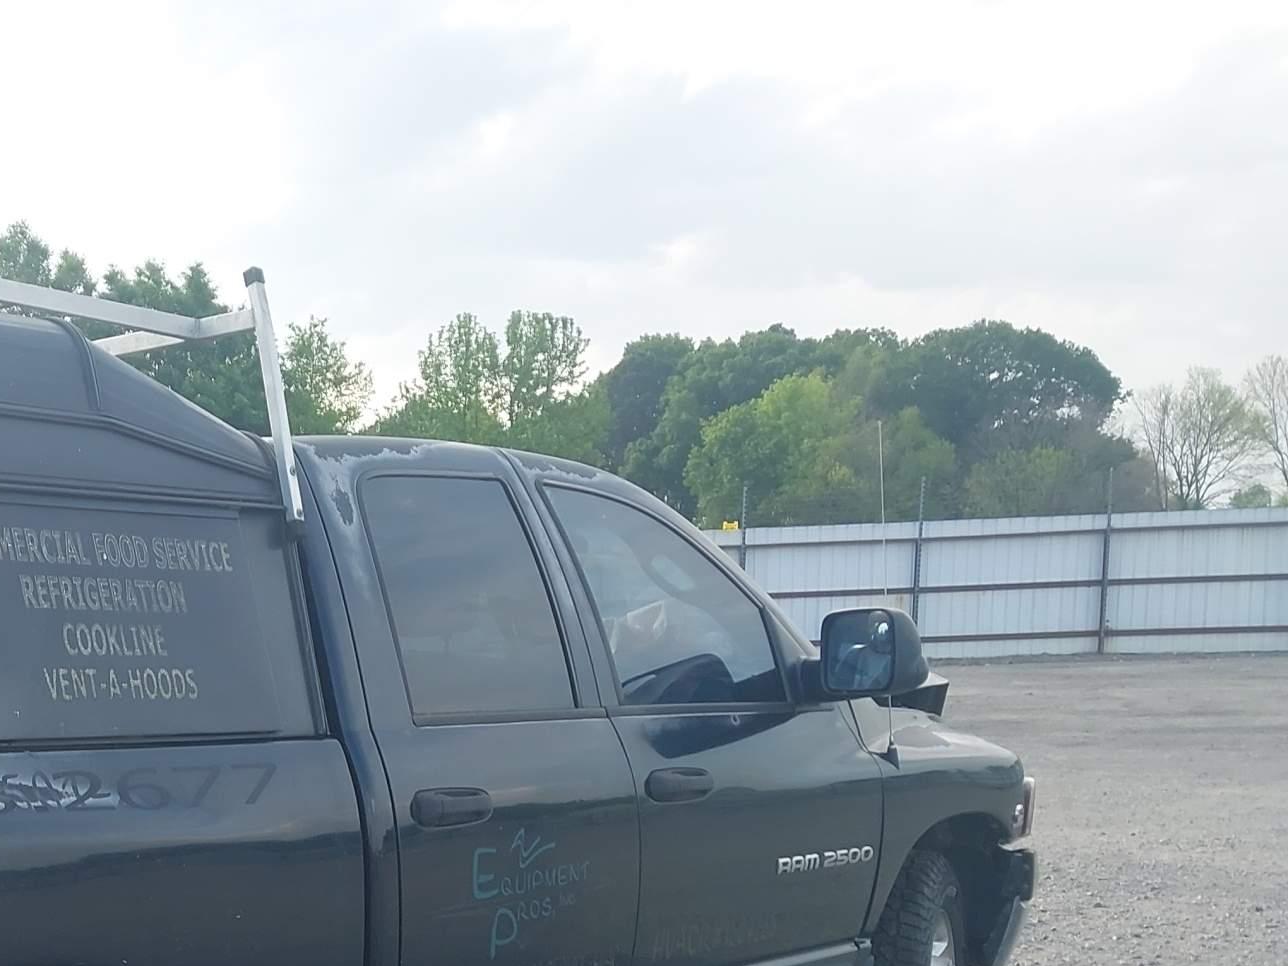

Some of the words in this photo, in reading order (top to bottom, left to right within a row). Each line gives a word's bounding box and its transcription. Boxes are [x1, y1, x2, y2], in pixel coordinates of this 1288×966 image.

[92, 532, 149, 569] FOOD
[152, 537, 234, 573] SERVICE
[18, 574, 189, 614] REFRIGERATION
[62, 623, 168, 657] COOKLINE
[43, 666, 200, 701] VENT-A-HOODS
[472, 847, 590, 901] EQUIPMENT
[777, 853, 820, 875] RAM
[823, 846, 874, 868] 2500
